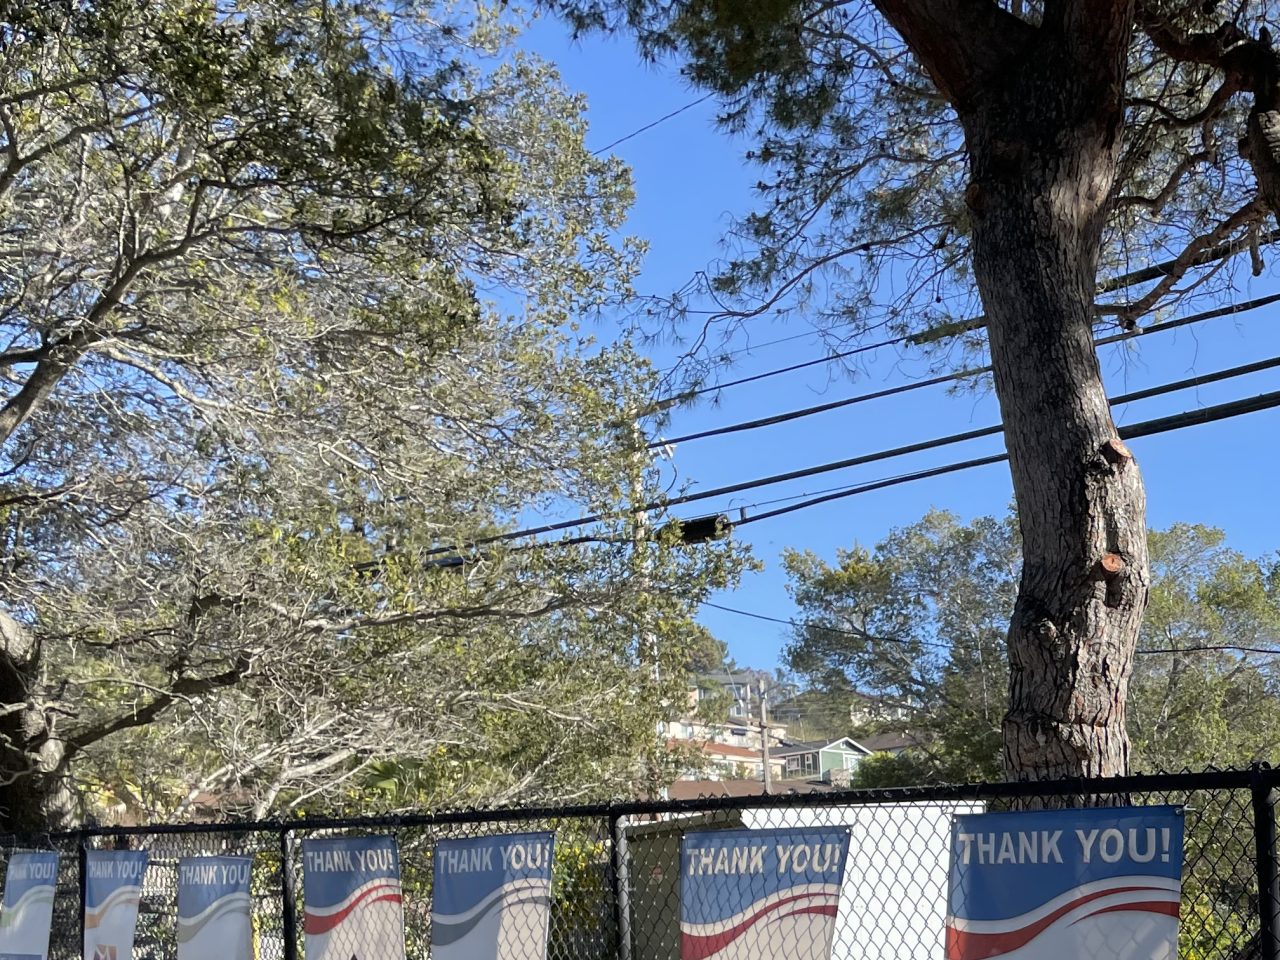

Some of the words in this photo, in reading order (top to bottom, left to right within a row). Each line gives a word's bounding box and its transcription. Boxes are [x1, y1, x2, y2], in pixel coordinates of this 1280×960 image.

[306, 849, 354, 872] THANK
[357, 848, 394, 871] YOU!
[438, 847, 494, 875] THANK
[501, 843, 549, 871] YOU!
[686, 845, 768, 876] THANK
[776, 843, 842, 874] YOU!
[959, 830, 1064, 865] THANK
[1075, 827, 1171, 864] YOU!
[180, 865, 217, 885] THANK
